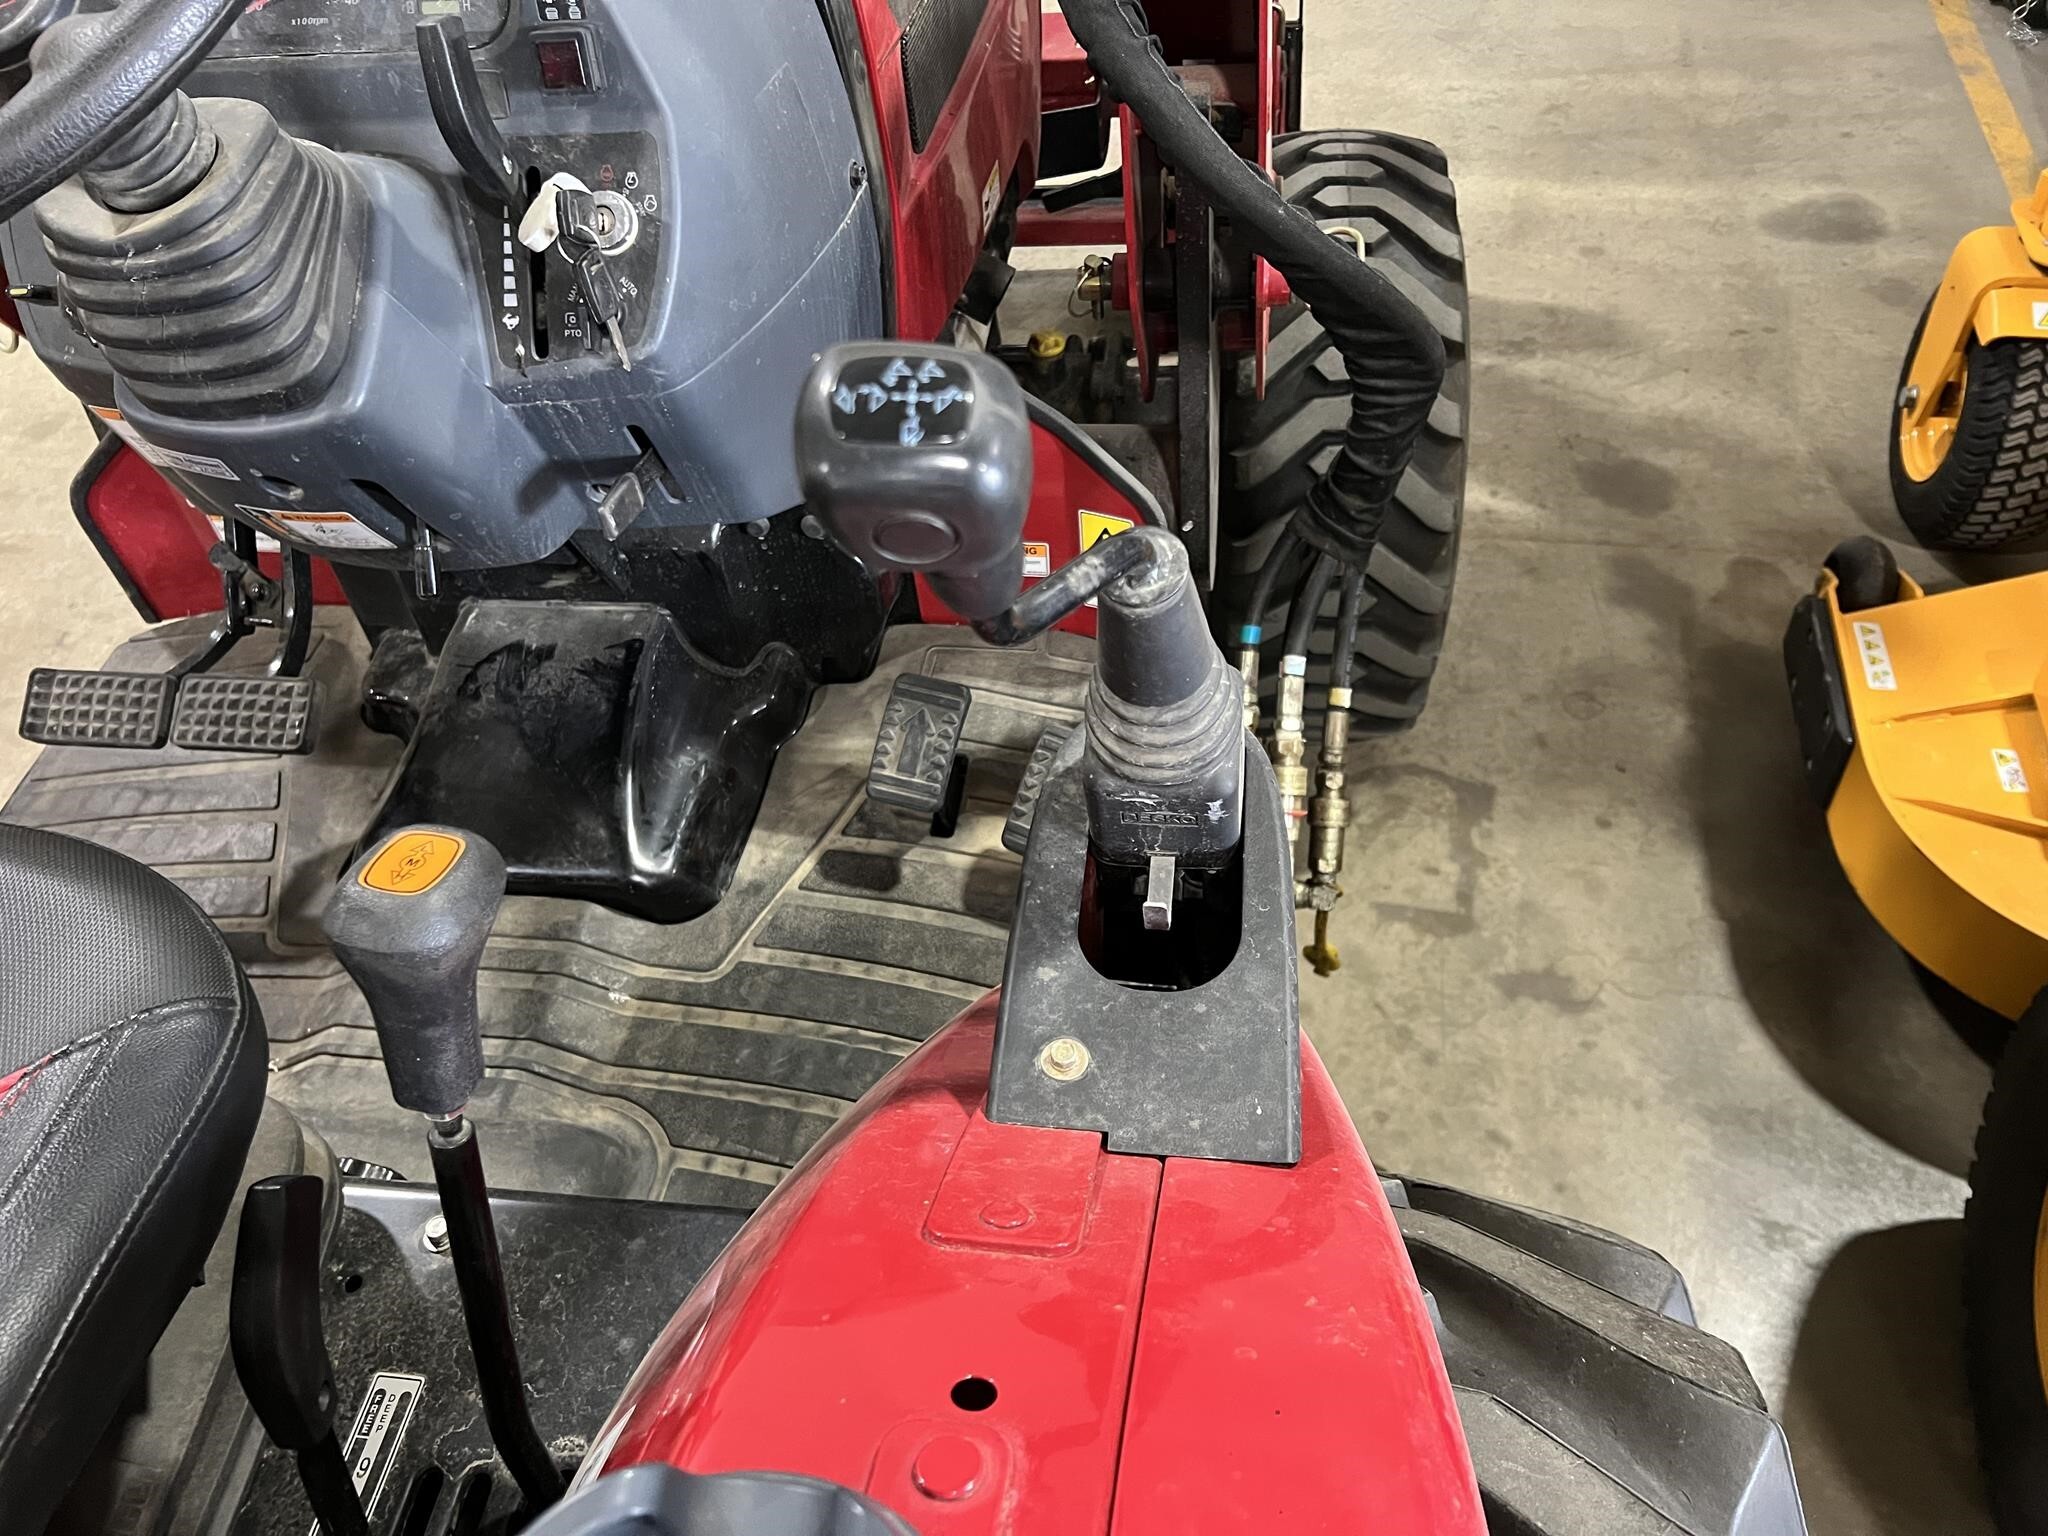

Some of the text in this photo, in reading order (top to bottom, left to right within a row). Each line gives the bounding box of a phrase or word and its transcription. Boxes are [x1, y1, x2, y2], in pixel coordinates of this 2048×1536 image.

[619, 276, 638, 295] AUTO
[564, 329, 582, 338] PTO
[361, 1394, 383, 1434] FREE
[375, 1393, 396, 1433] DEEP
[356, 1457, 371, 1478] 9
